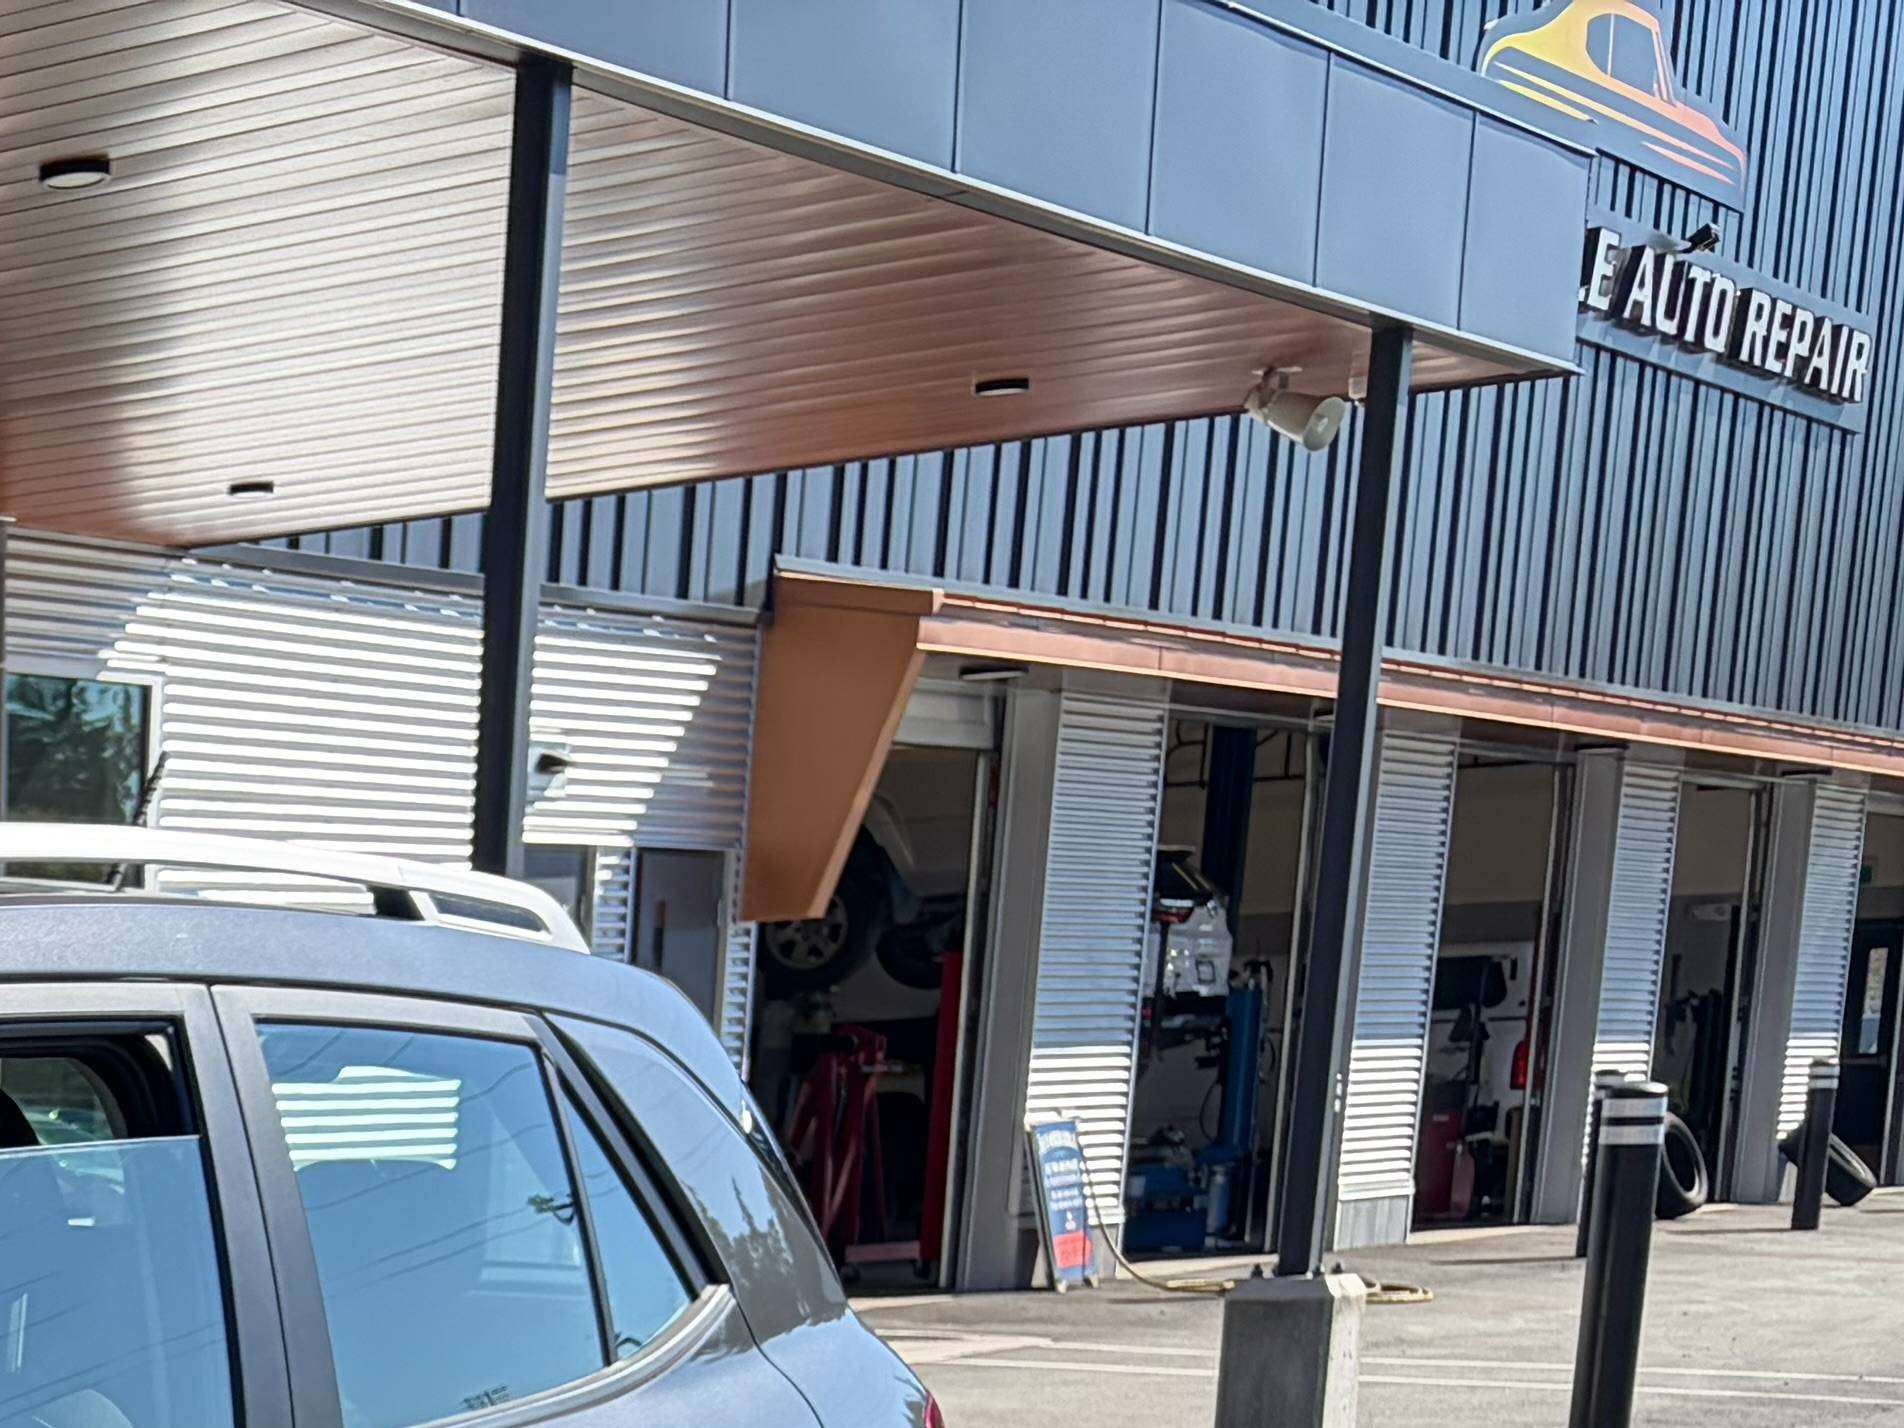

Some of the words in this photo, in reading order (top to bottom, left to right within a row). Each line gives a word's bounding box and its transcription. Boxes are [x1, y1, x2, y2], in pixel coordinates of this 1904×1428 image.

[1579, 227, 1620, 311] E
[1623, 245, 1737, 354] AUTO
[1739, 287, 1873, 402] REPAIR
